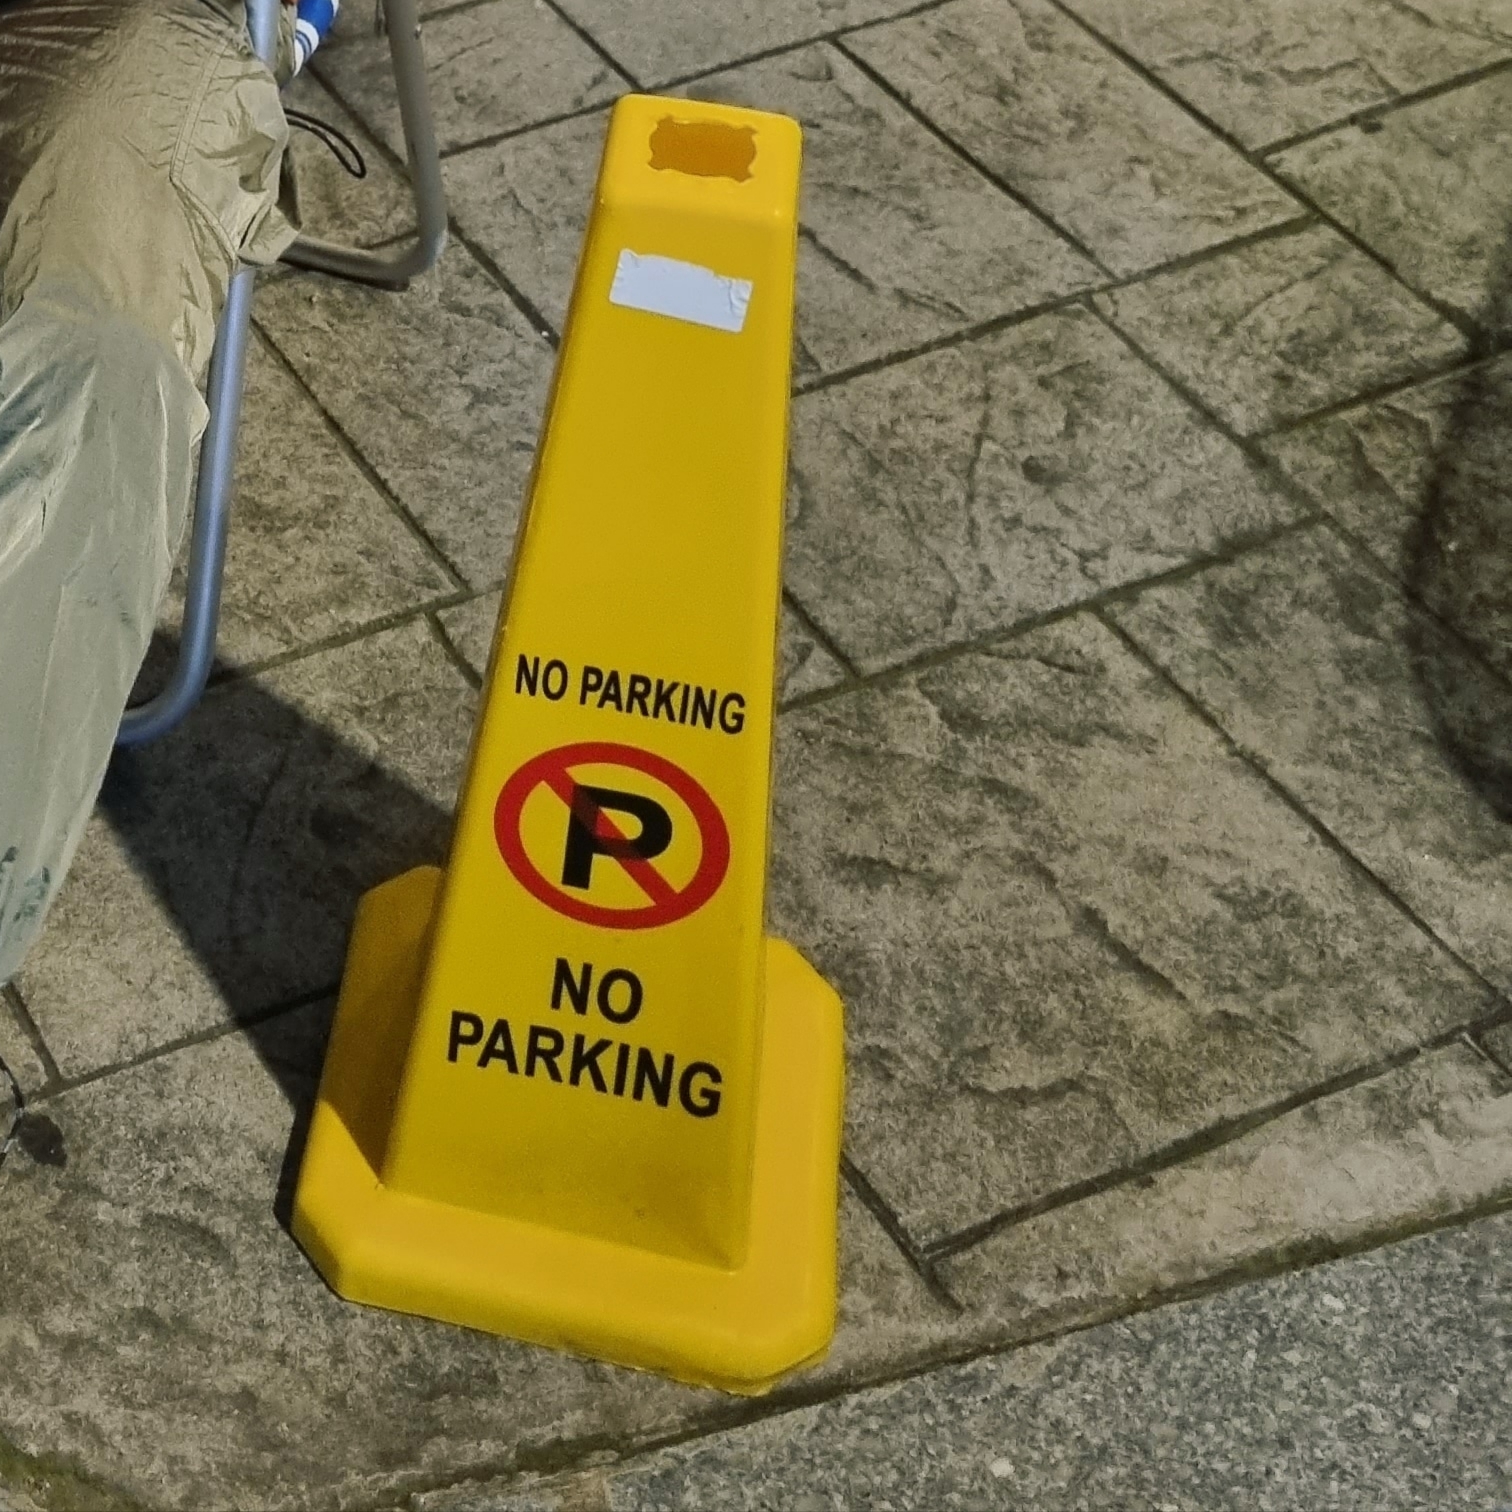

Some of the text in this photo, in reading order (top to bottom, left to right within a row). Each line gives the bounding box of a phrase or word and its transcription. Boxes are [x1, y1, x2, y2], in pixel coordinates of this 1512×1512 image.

[514, 654, 746, 735] NO PARKING
[561, 784, 673, 890] P
[550, 958, 644, 1024] NO
[447, 1011, 723, 1118] PARKING
